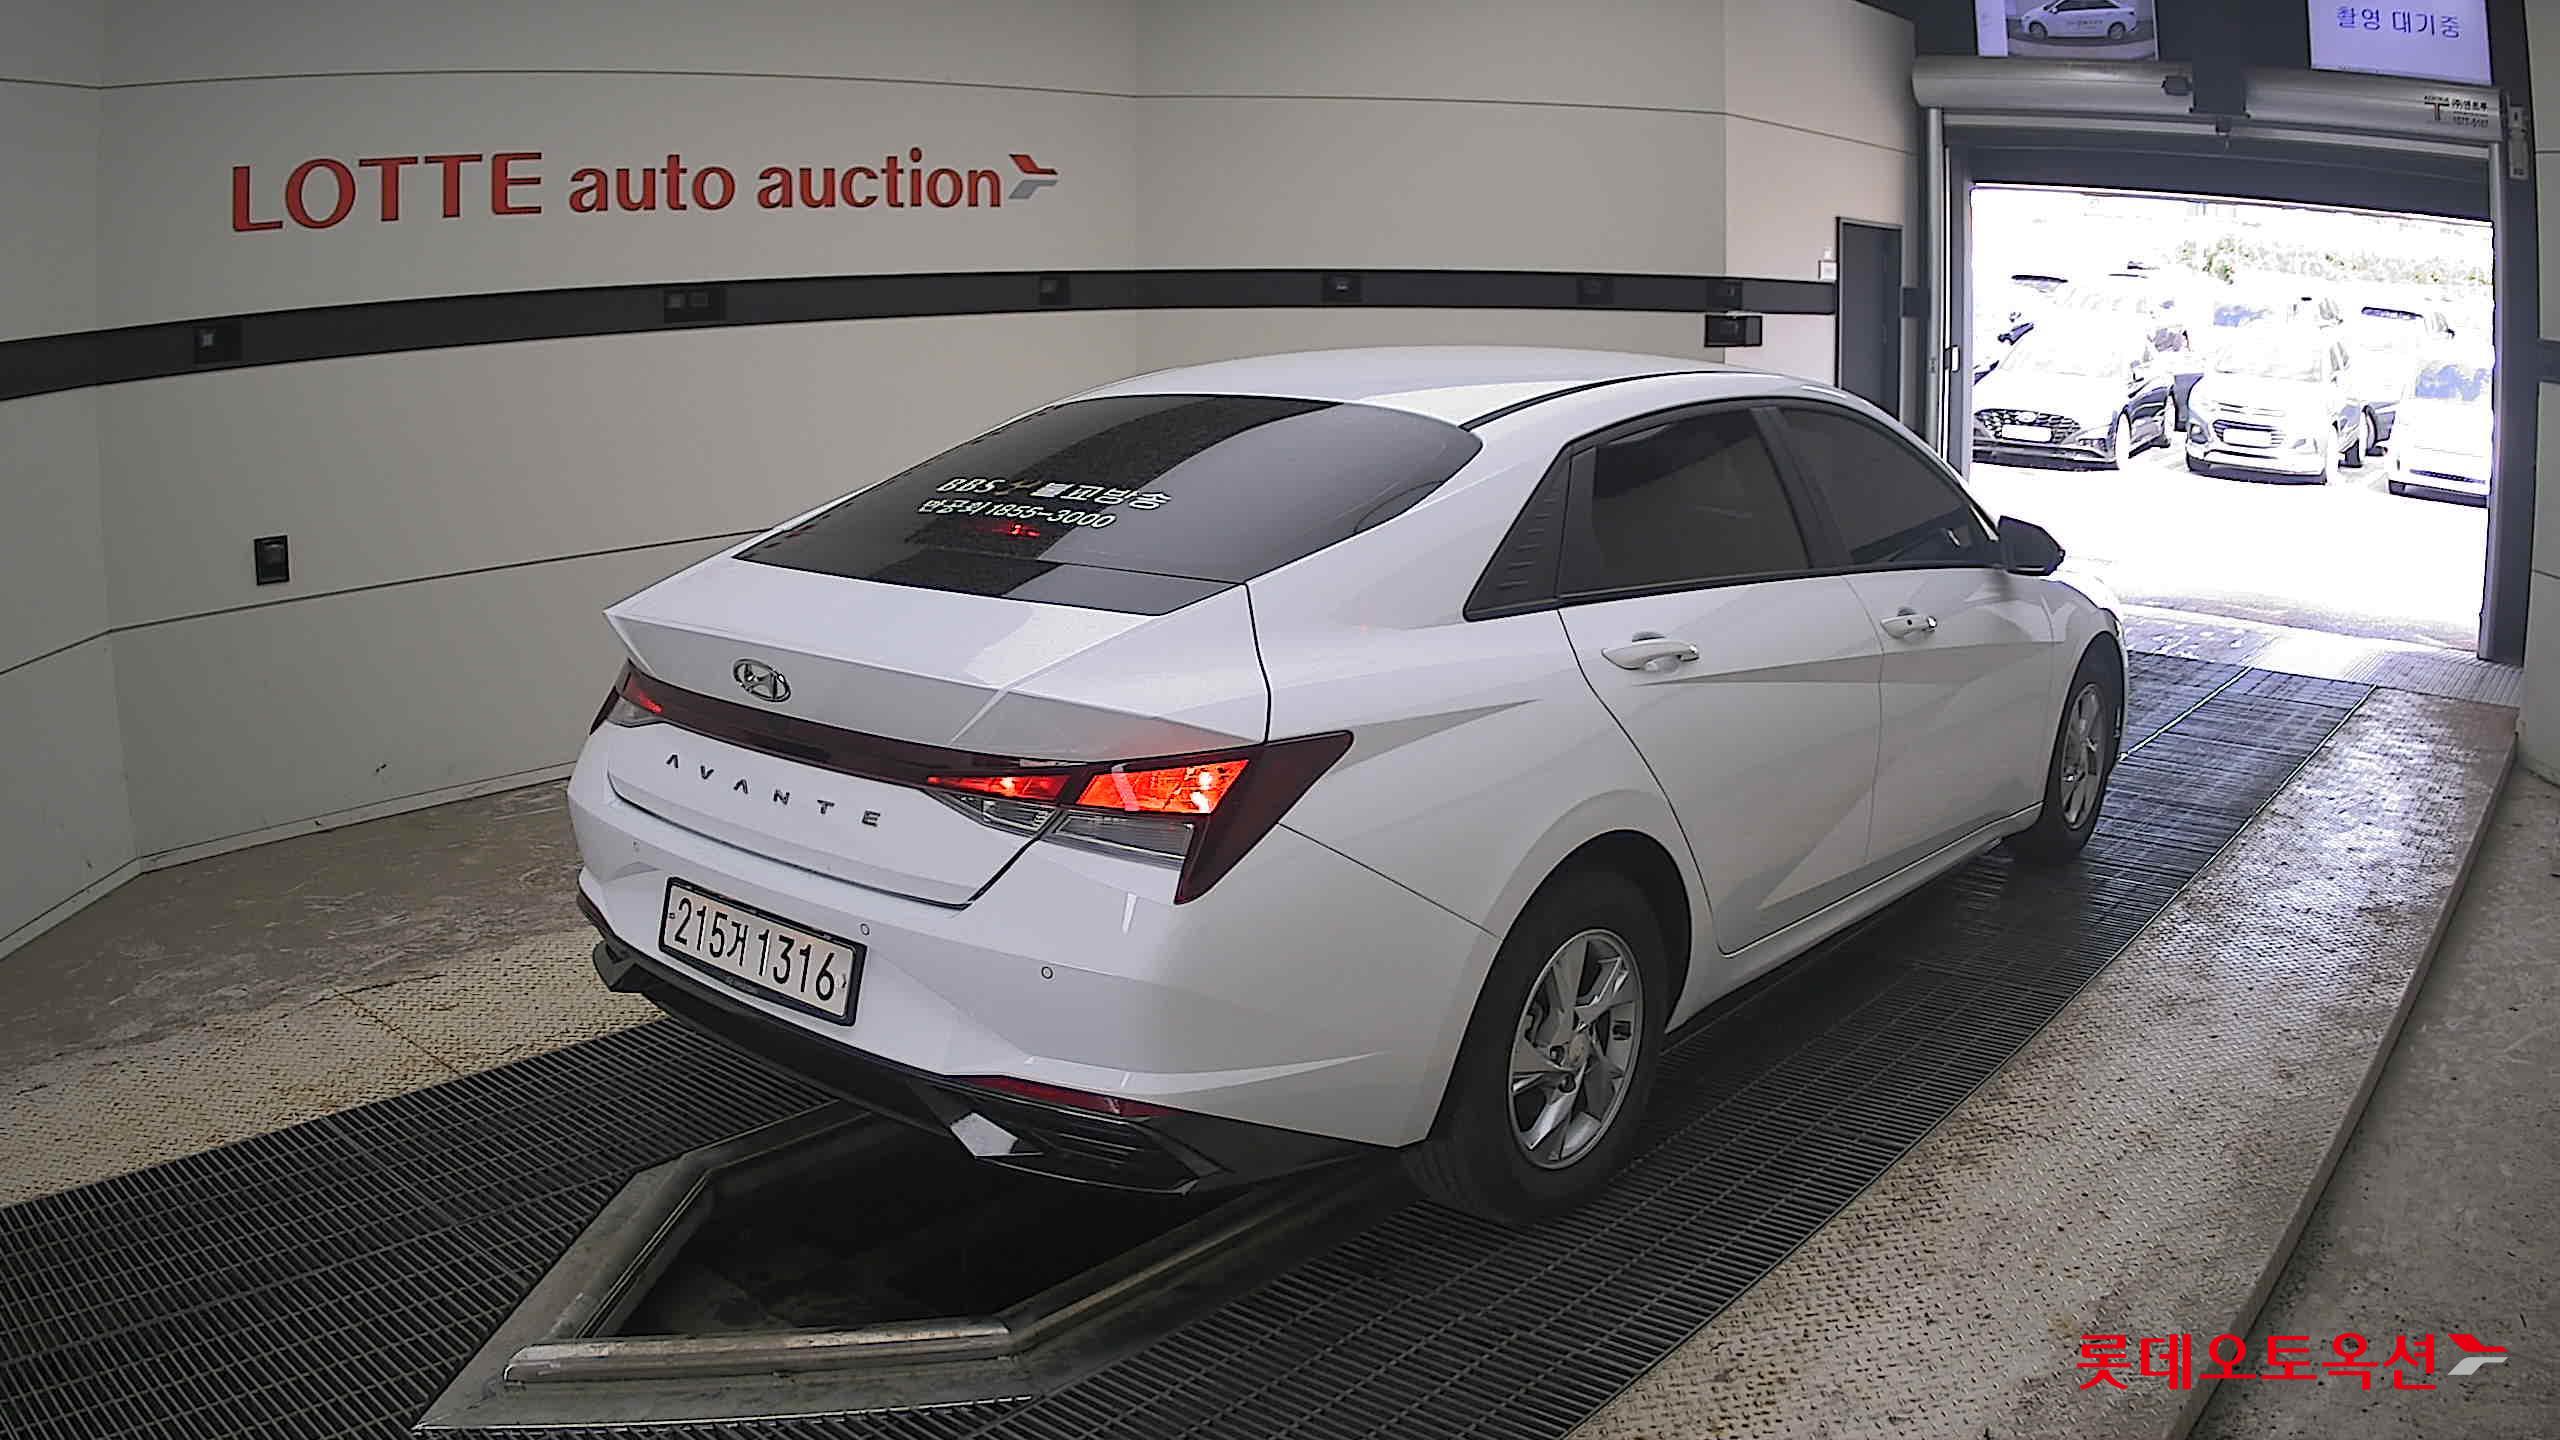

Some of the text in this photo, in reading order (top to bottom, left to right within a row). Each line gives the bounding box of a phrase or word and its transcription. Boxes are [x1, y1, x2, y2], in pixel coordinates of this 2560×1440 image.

[2392, 11, 2461, 39] 대기중
[232, 147, 1001, 232] LOTTE auto auction
[937, 478, 1004, 494] BBS
[985, 503, 1117, 528] 1855-3000
[667, 754, 881, 827] AVANTE
[758, 928, 835, 1001] 1316
